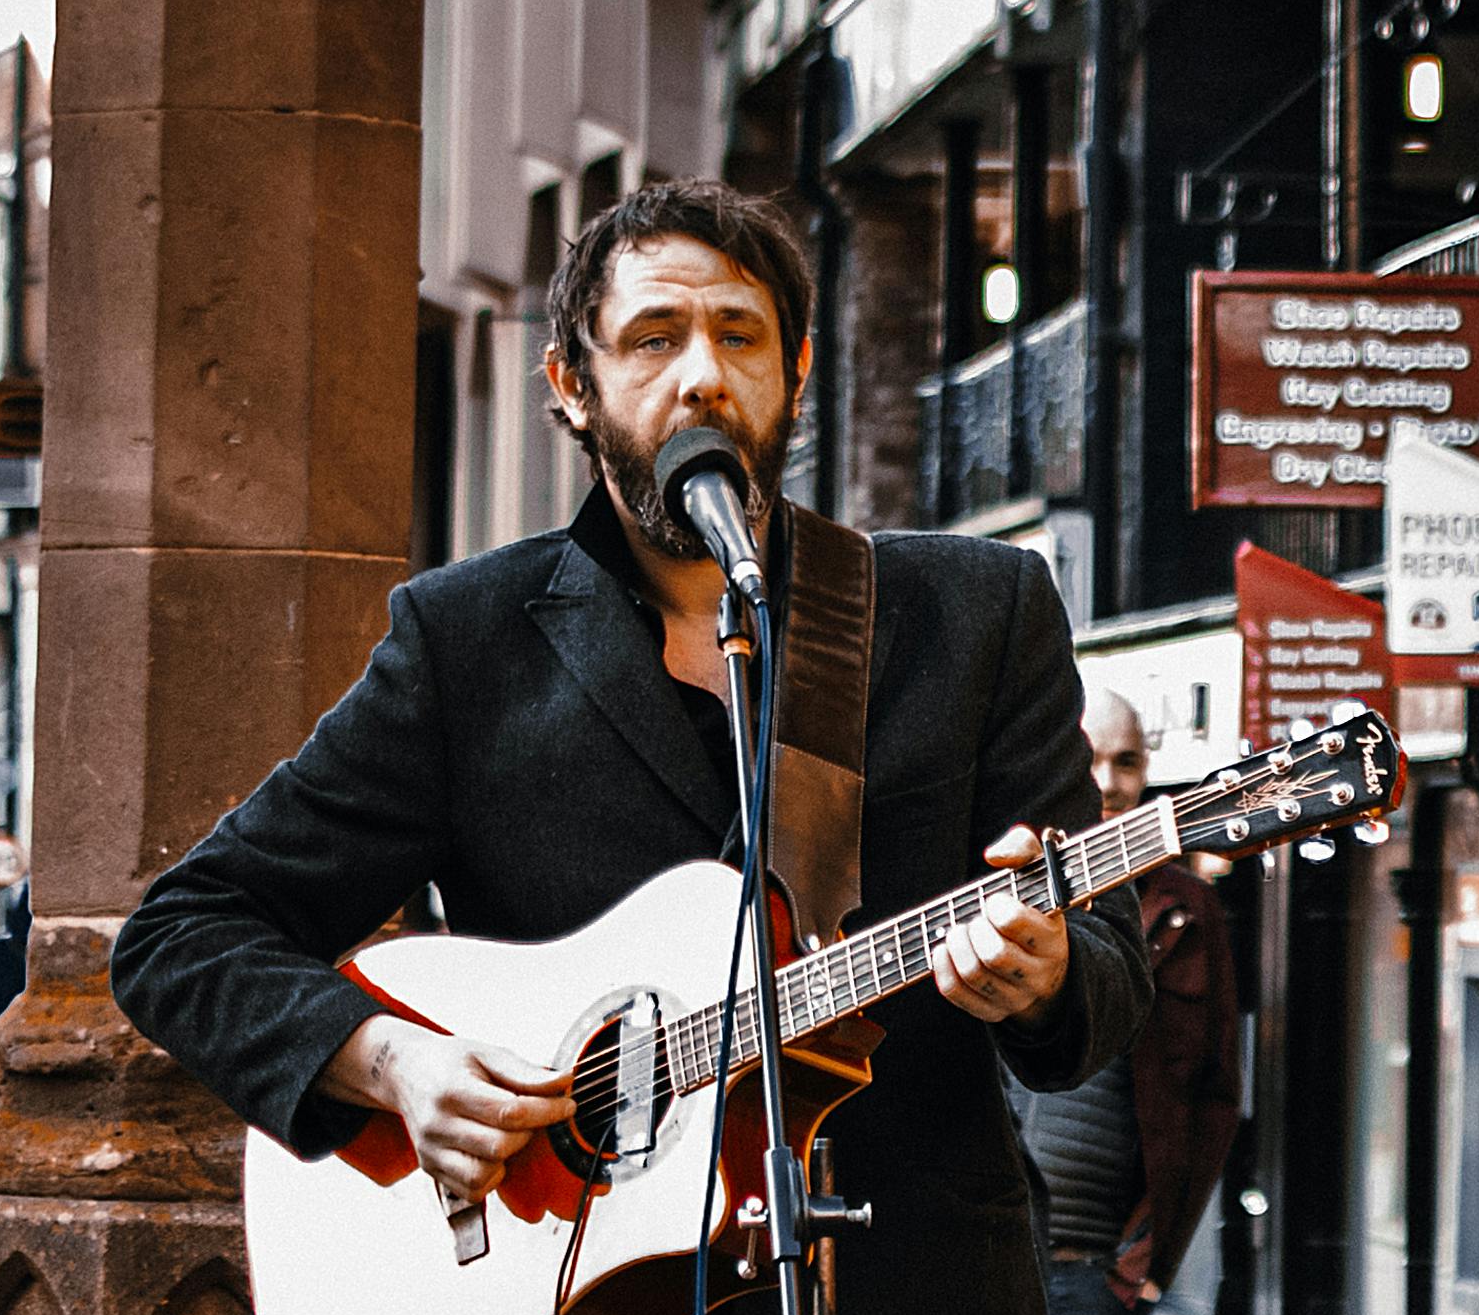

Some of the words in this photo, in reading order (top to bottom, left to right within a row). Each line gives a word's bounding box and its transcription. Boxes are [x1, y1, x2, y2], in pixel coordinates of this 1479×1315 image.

[1275, 300, 1348, 329] Shoe
[1354, 301, 1461, 333] Repairs
[1262, 341, 1356, 366] Watch
[1363, 340, 1469, 371] Repairs
[1282, 377, 1341, 410] Key
[1343, 378, 1451, 412] Cutting
[1217, 415, 1363, 450] Engraving
[1274, 454, 1331, 487] Dry
